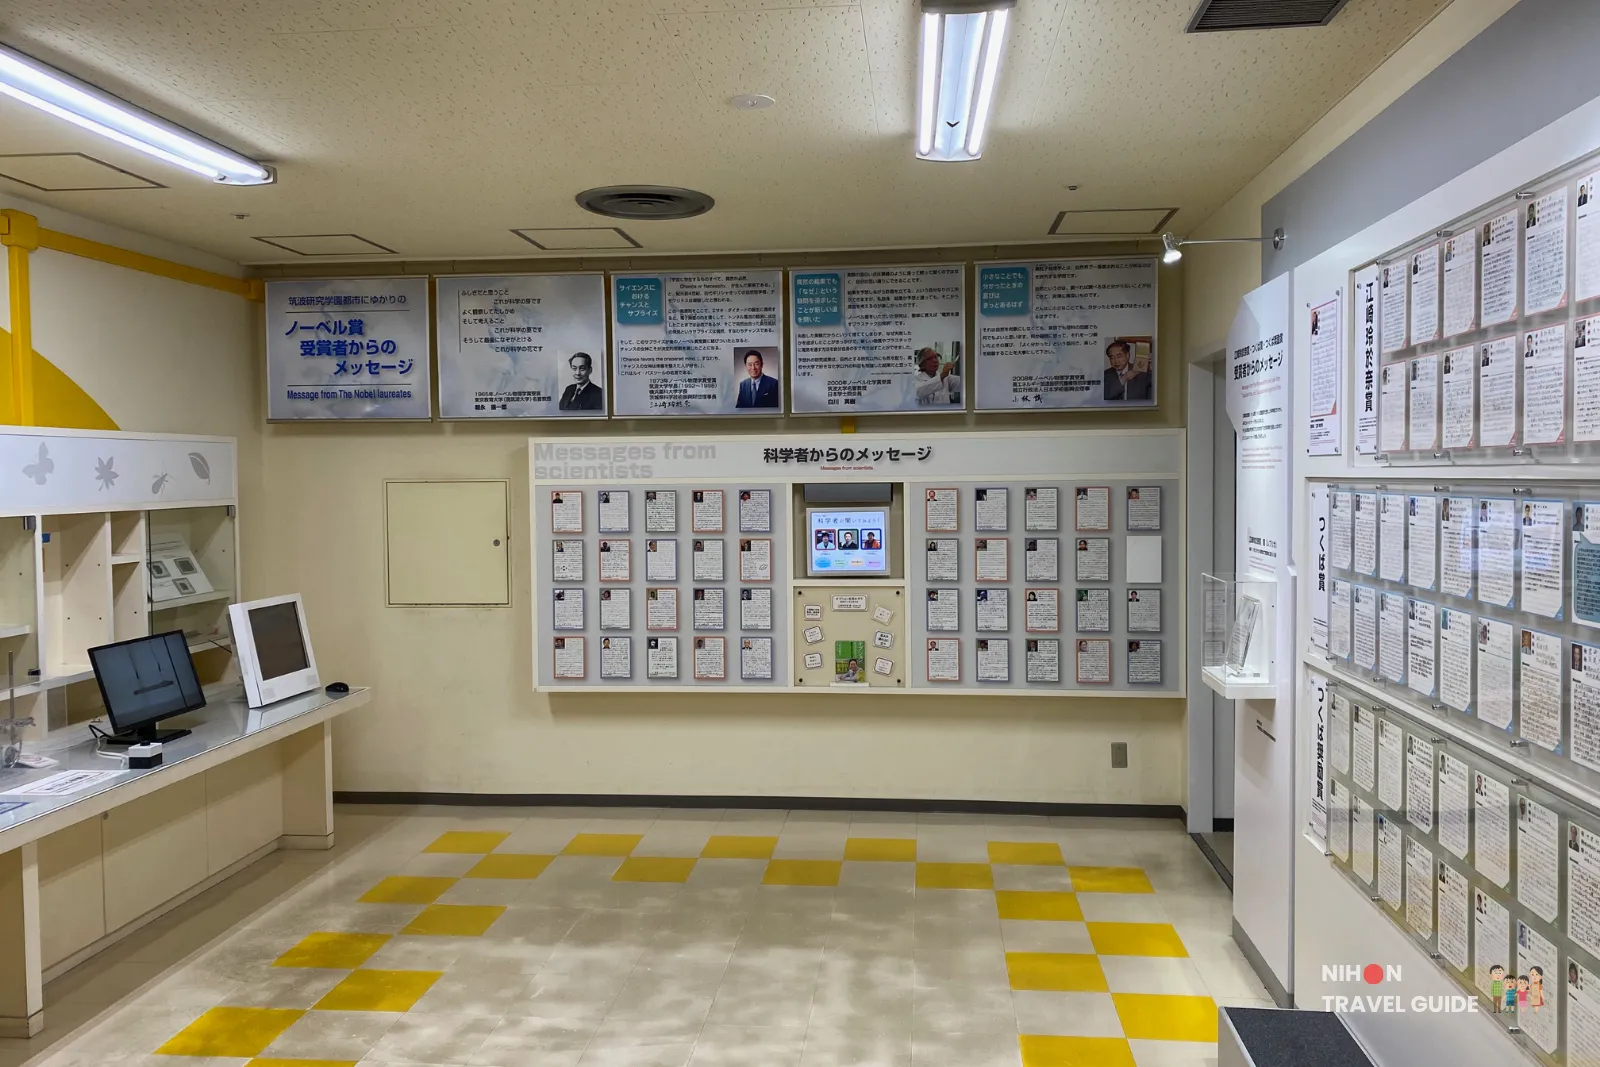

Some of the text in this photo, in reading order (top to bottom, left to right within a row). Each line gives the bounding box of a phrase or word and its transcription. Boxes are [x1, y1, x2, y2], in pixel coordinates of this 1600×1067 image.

[288, 295, 407, 306] 筑波研究学園都市にゆかりの
[285, 319, 364, 336] ノーベル賞
[300, 340, 397, 357] 受賞者からの
[1365, 282, 1374, 412] 江崎玲於奈賞
[333, 359, 413, 376] メッセージ
[287, 389, 412, 401] Message from The Nobel laureates
[534, 442, 717, 463] Messages from
[763, 446, 932, 464] 科学者からのメッセージ
[534, 462, 654, 479] scientists
[1318, 516, 1326, 592] つくば賞
